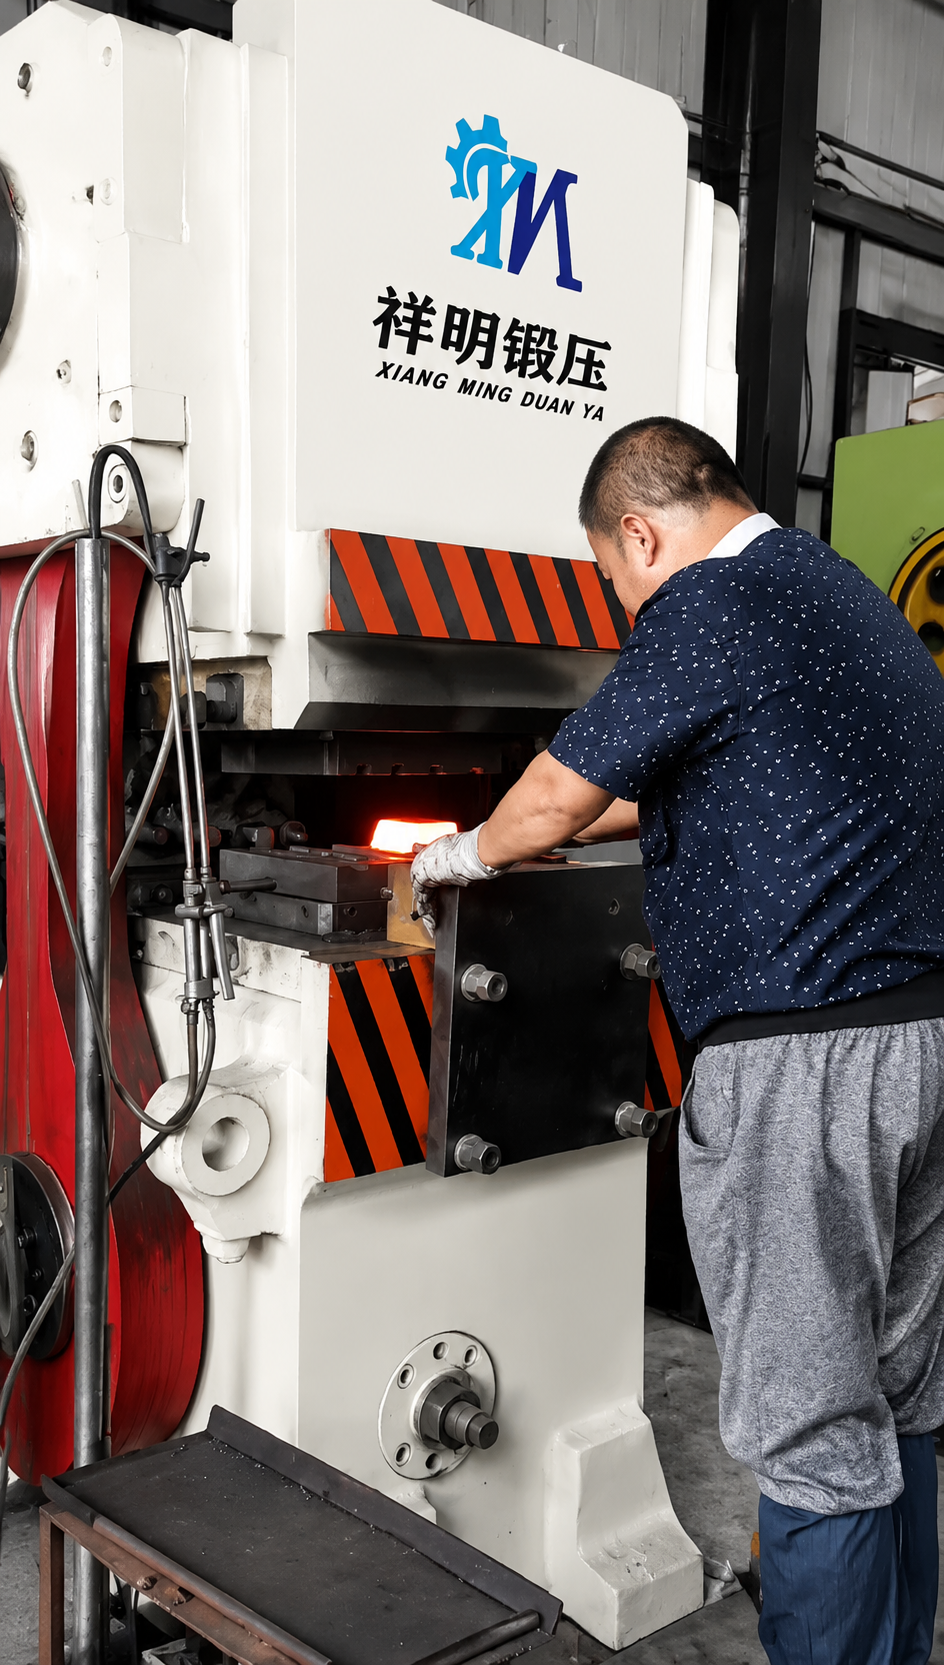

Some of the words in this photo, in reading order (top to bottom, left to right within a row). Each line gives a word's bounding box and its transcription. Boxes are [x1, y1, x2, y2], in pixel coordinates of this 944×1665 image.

[372, 285, 612, 392] 祥明锻压
[375, 360, 449, 390] XIANG
[456, 377, 513, 403] MING
[519, 391, 575, 416] DUAN
[583, 403, 605, 422] YA
